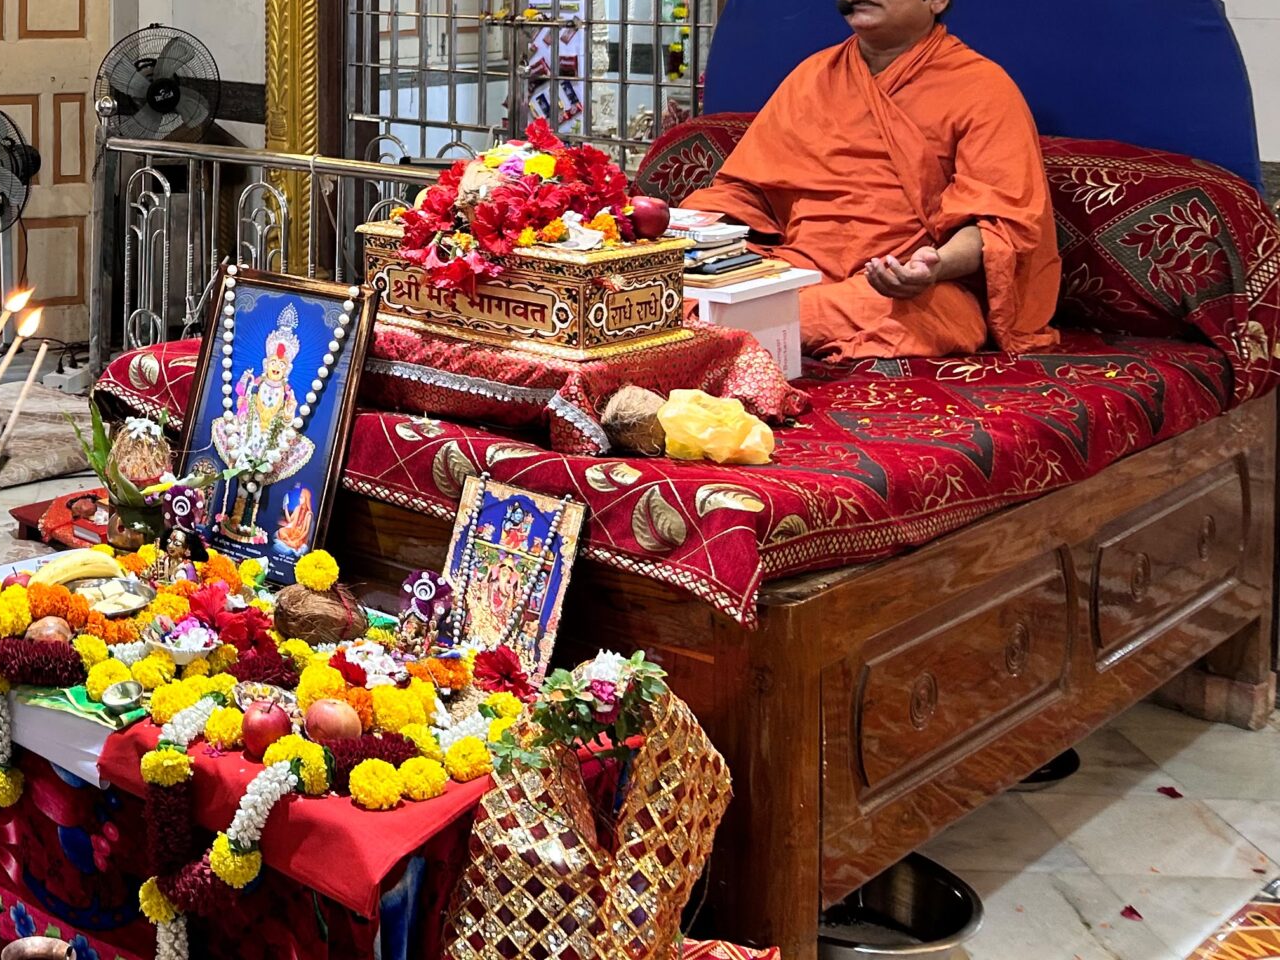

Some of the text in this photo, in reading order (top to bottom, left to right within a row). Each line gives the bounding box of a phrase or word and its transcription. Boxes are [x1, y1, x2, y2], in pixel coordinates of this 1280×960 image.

[392, 275, 420, 302] श्री
[467, 291, 549, 324] भागवत
[610, 292, 660, 326] राधे राधे
